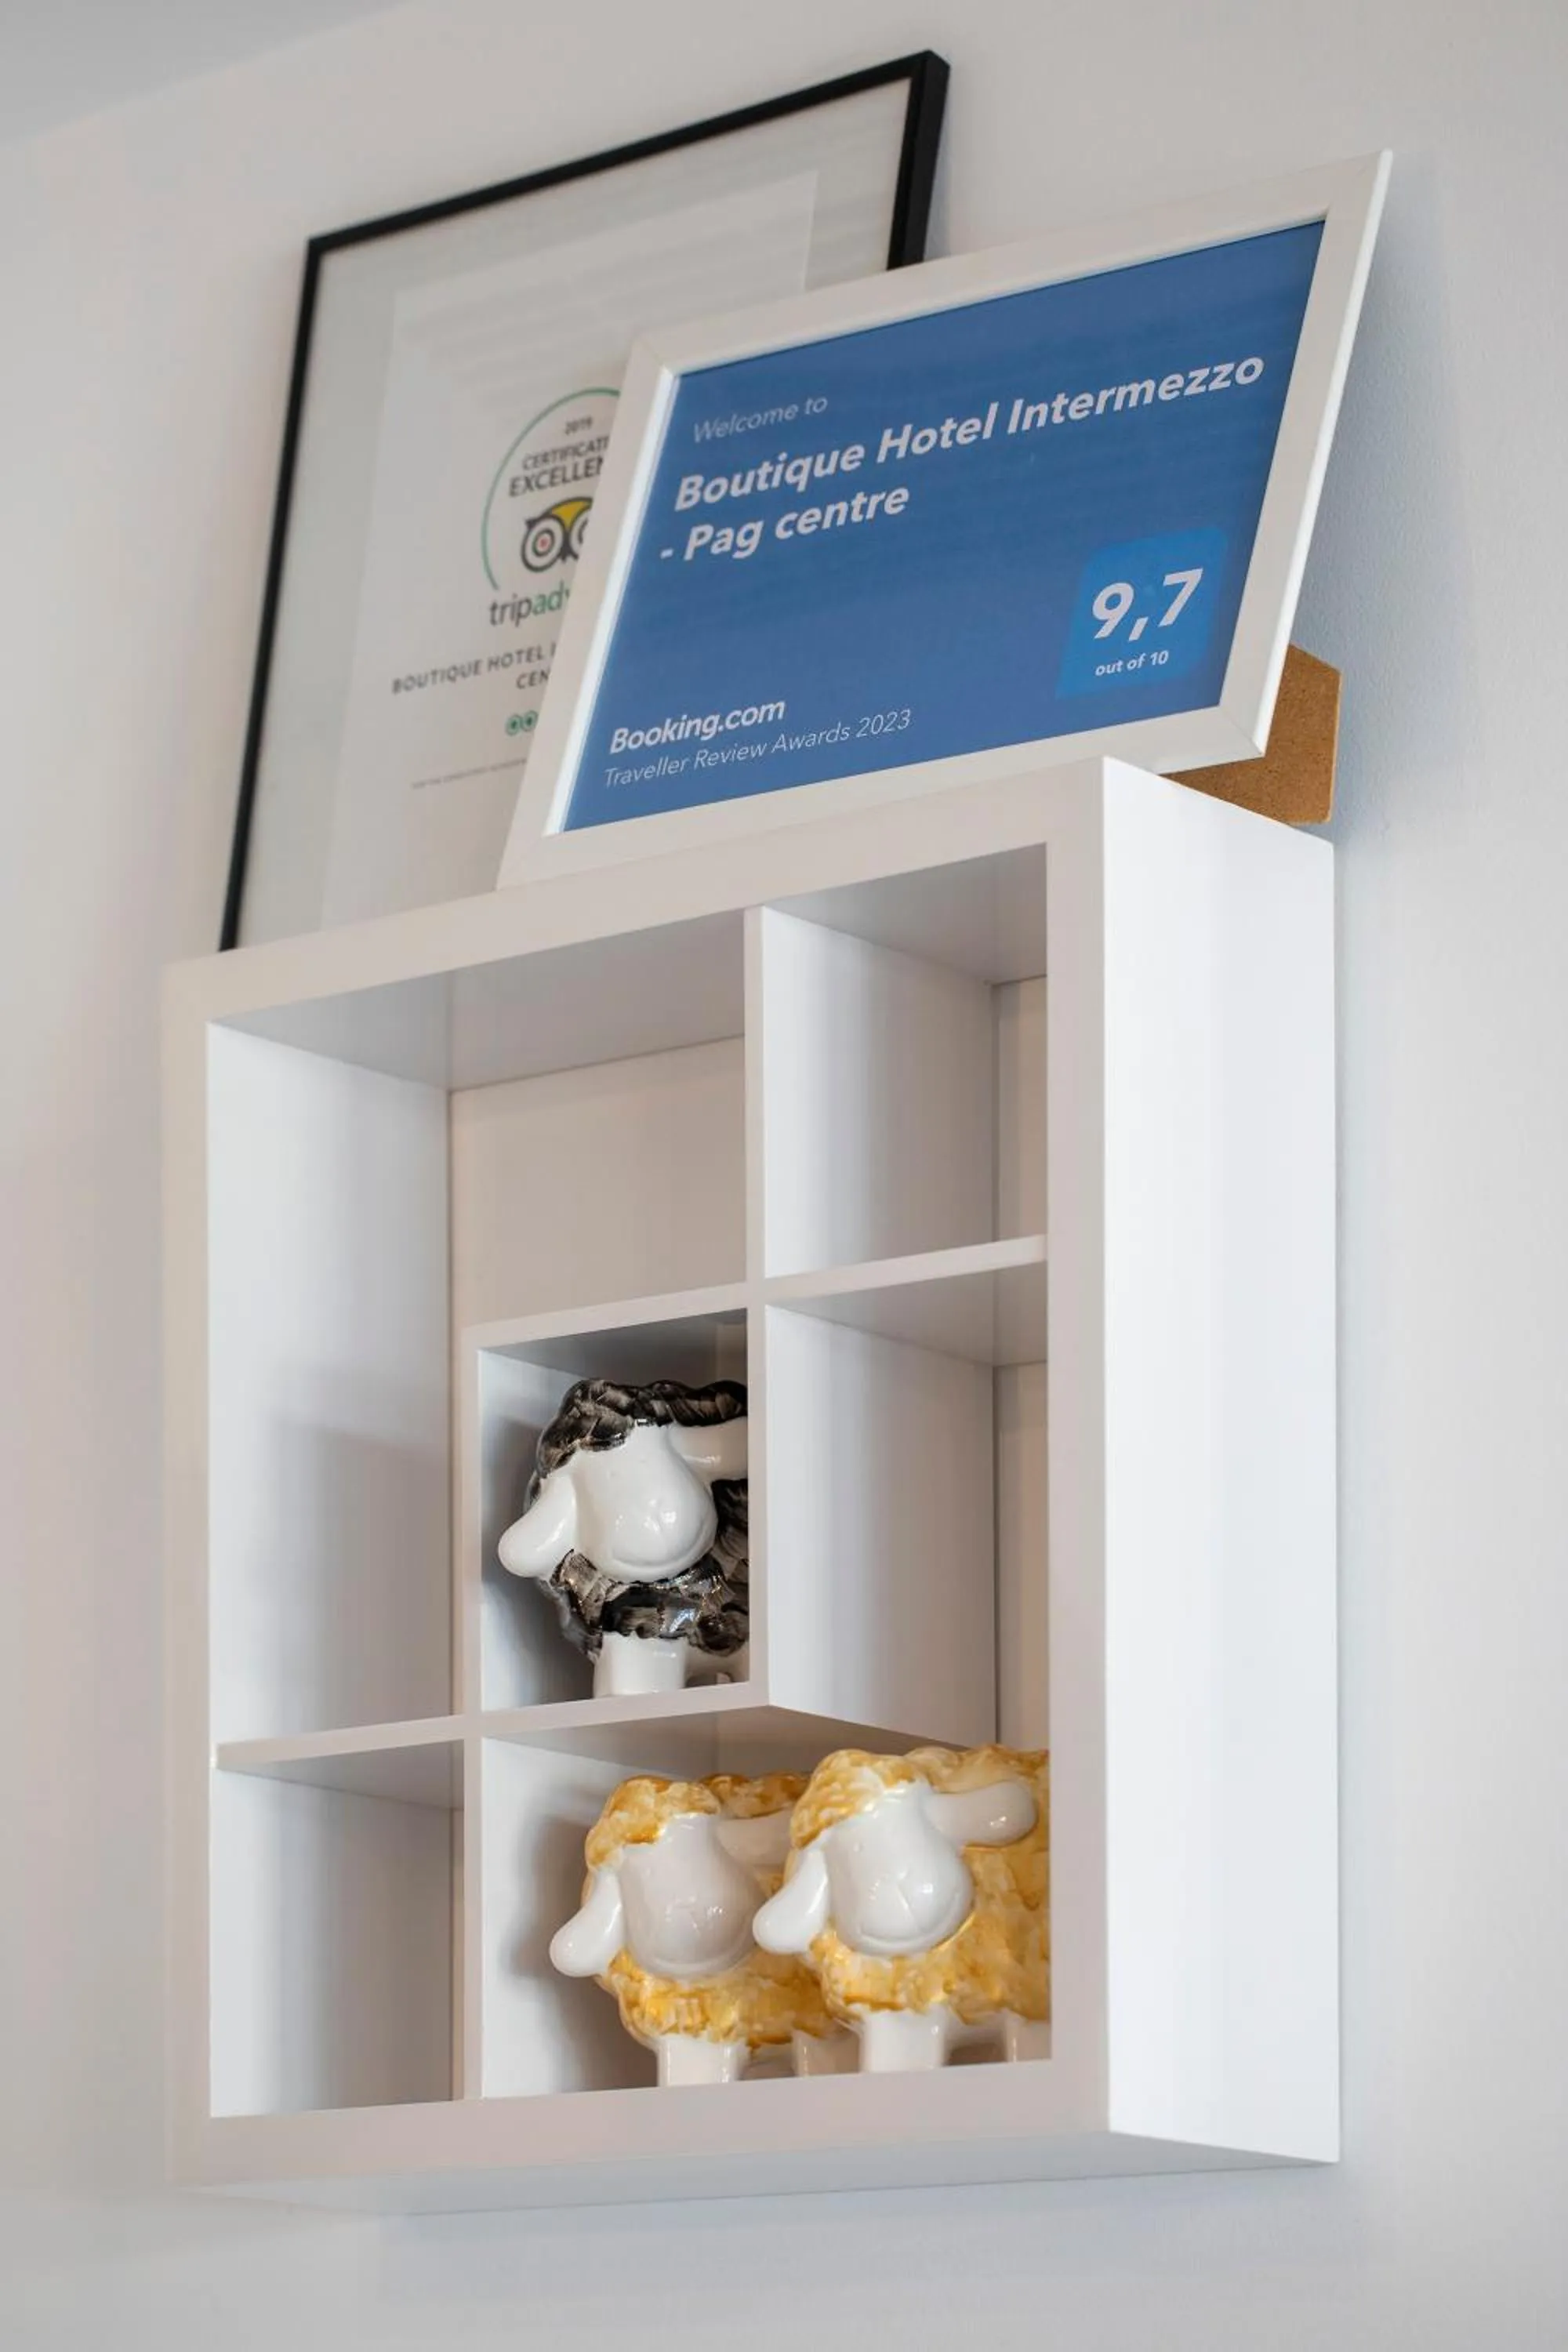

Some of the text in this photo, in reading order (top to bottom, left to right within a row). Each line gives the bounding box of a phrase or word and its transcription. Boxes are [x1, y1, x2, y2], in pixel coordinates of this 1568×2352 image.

[674, 357, 1265, 513] Boutique Hotel Intermezzo
[693, 396, 828, 443] Welcome to
[683, 518, 764, 561] Pag
[775, 486, 909, 540] centre
[1092, 568, 1203, 641] 9,7
[392, 659, 481, 694] BOUTIQUE
[487, 644, 544, 673] HOTEL
[1094, 650, 1170, 677] out of 10
[603, 708, 913, 789] Traveller Review Awards 2023
[608, 699, 786, 756] Booking.com
